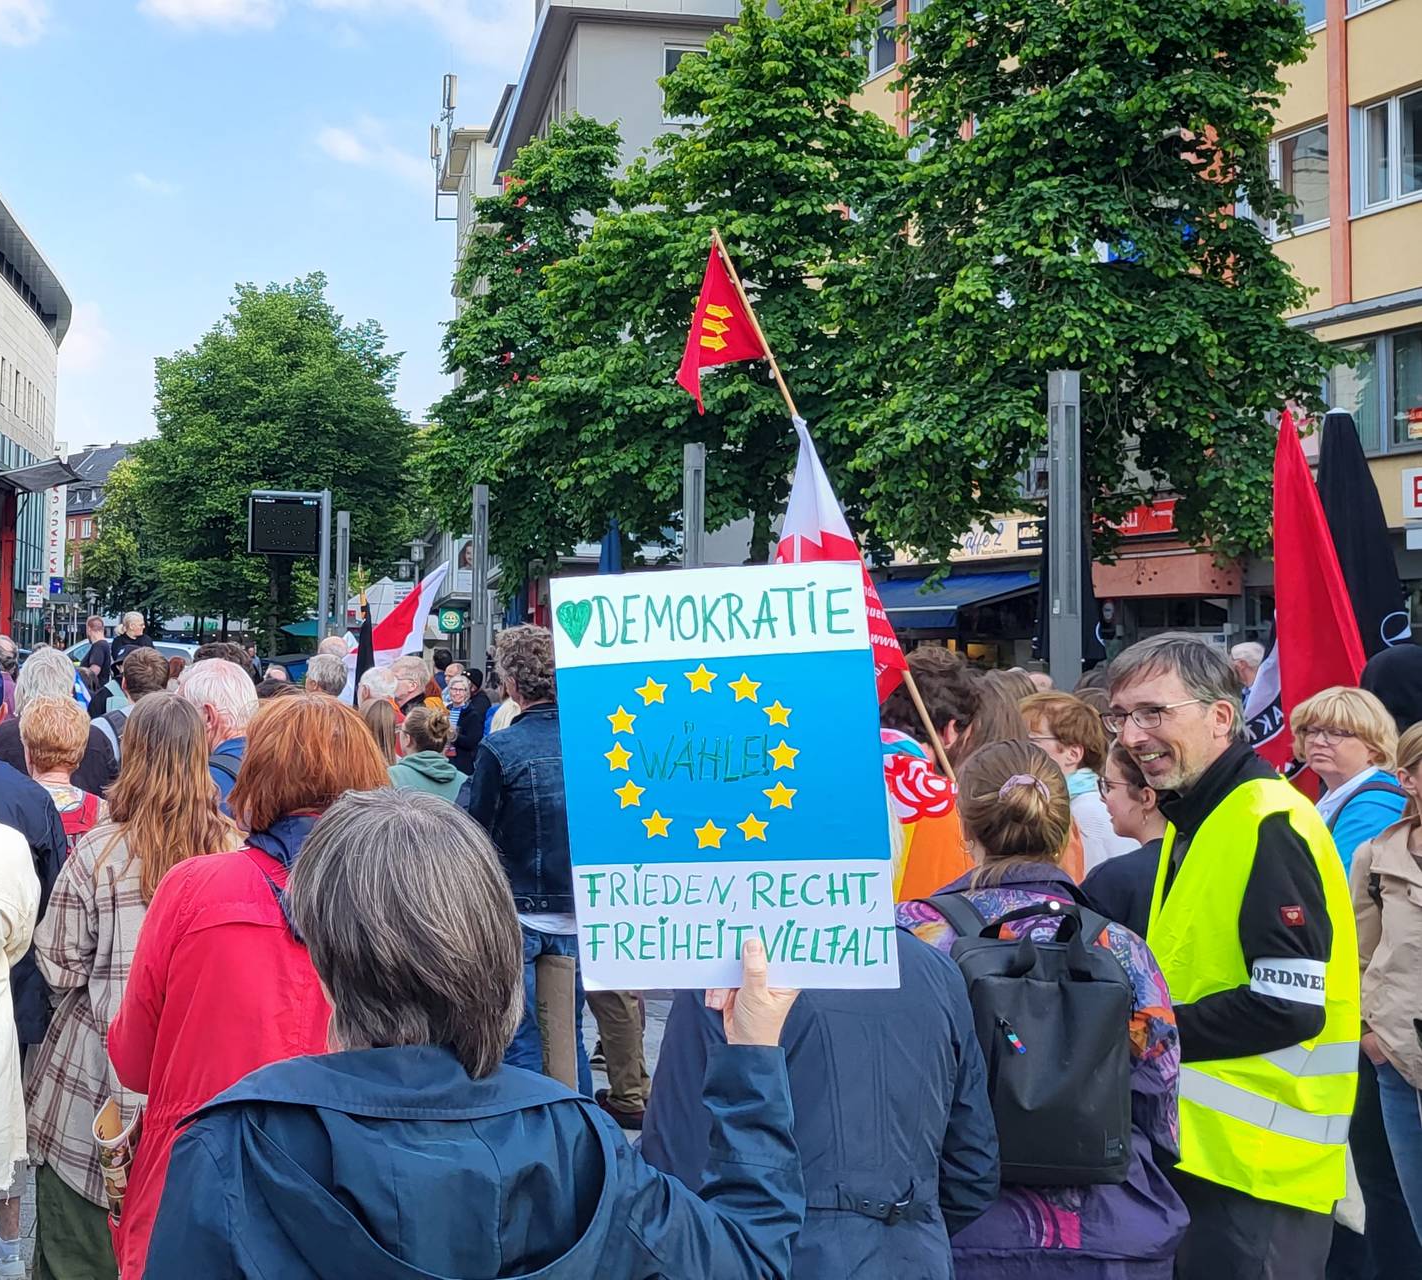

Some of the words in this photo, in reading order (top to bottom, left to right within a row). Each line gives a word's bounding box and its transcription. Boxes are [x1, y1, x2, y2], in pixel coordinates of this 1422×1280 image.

[638, 720, 771, 783] WÄHLE!
[746, 871, 880, 913] RECHT,
[1253, 966, 1325, 991] ORDNE
